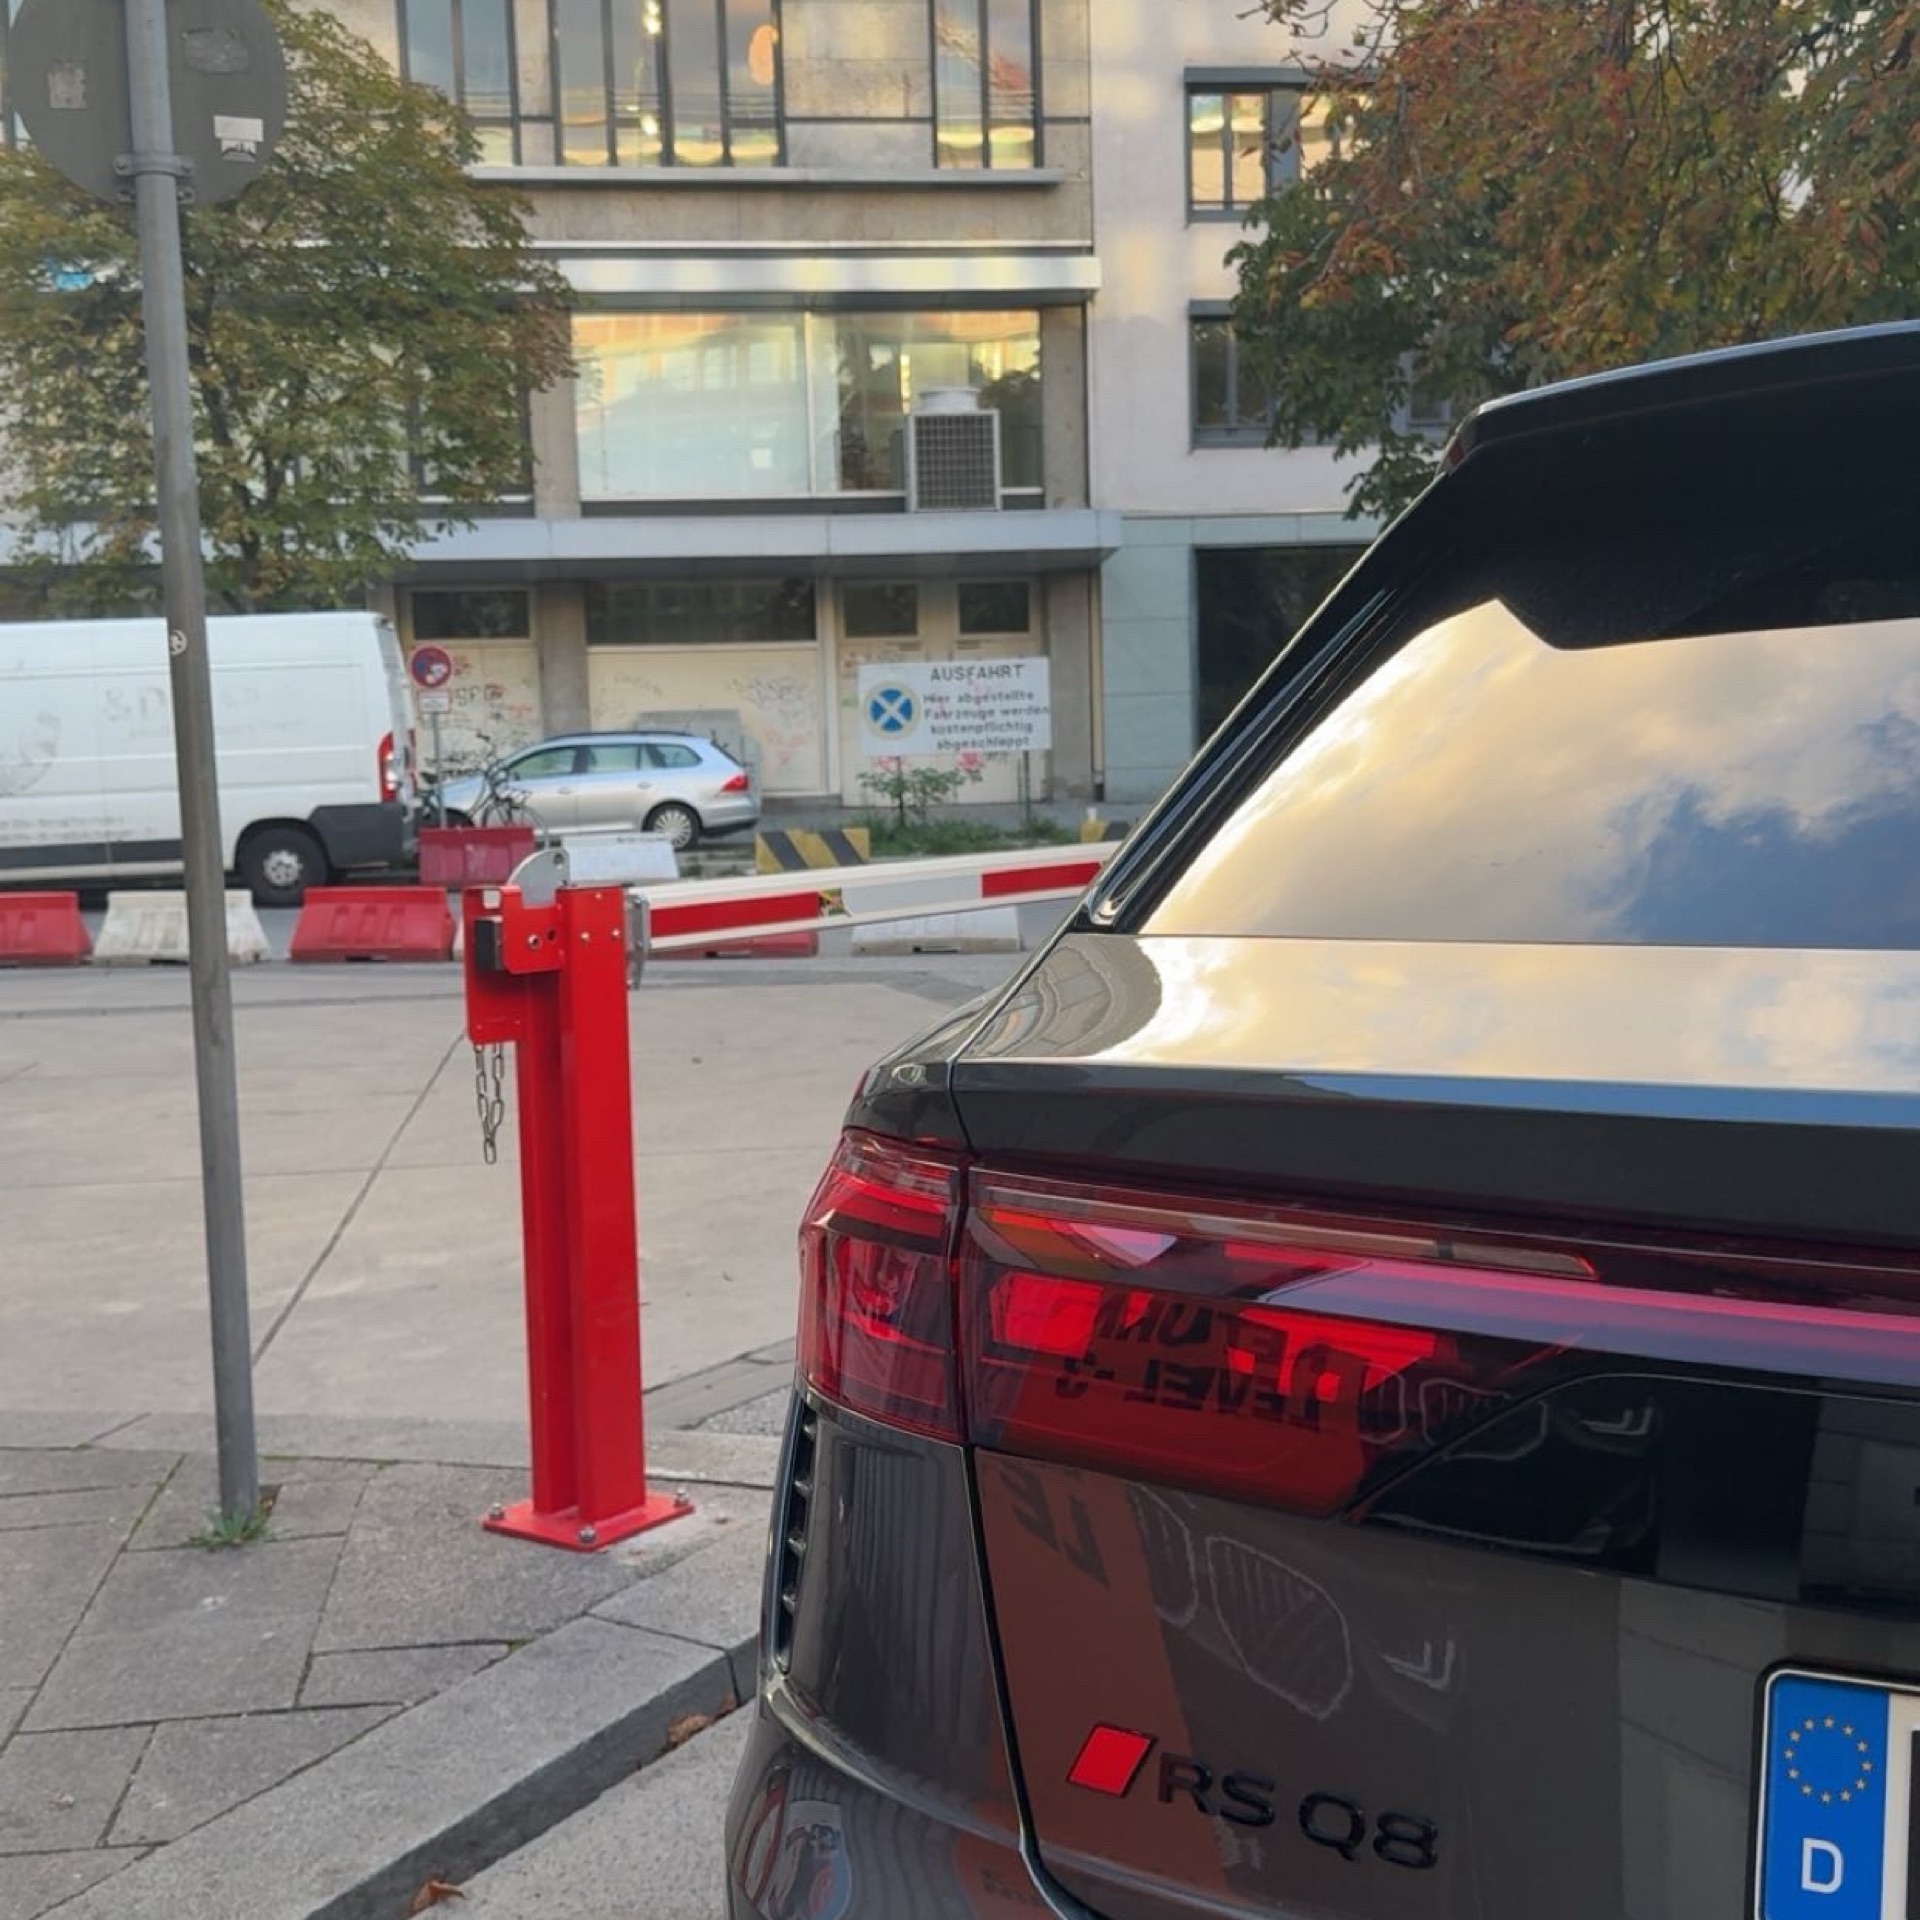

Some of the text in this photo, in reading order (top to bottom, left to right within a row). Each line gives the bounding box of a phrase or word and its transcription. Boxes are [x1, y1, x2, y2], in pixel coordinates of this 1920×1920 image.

[931, 664, 1026, 681] AUSFAHRT
[924, 707, 995, 720] Fahrzeuge
[930, 721, 1034, 735] kostenpflichtig
[1157, 1751, 1440, 1870] RS Q8
[1800, 1837, 1844, 1894] D
